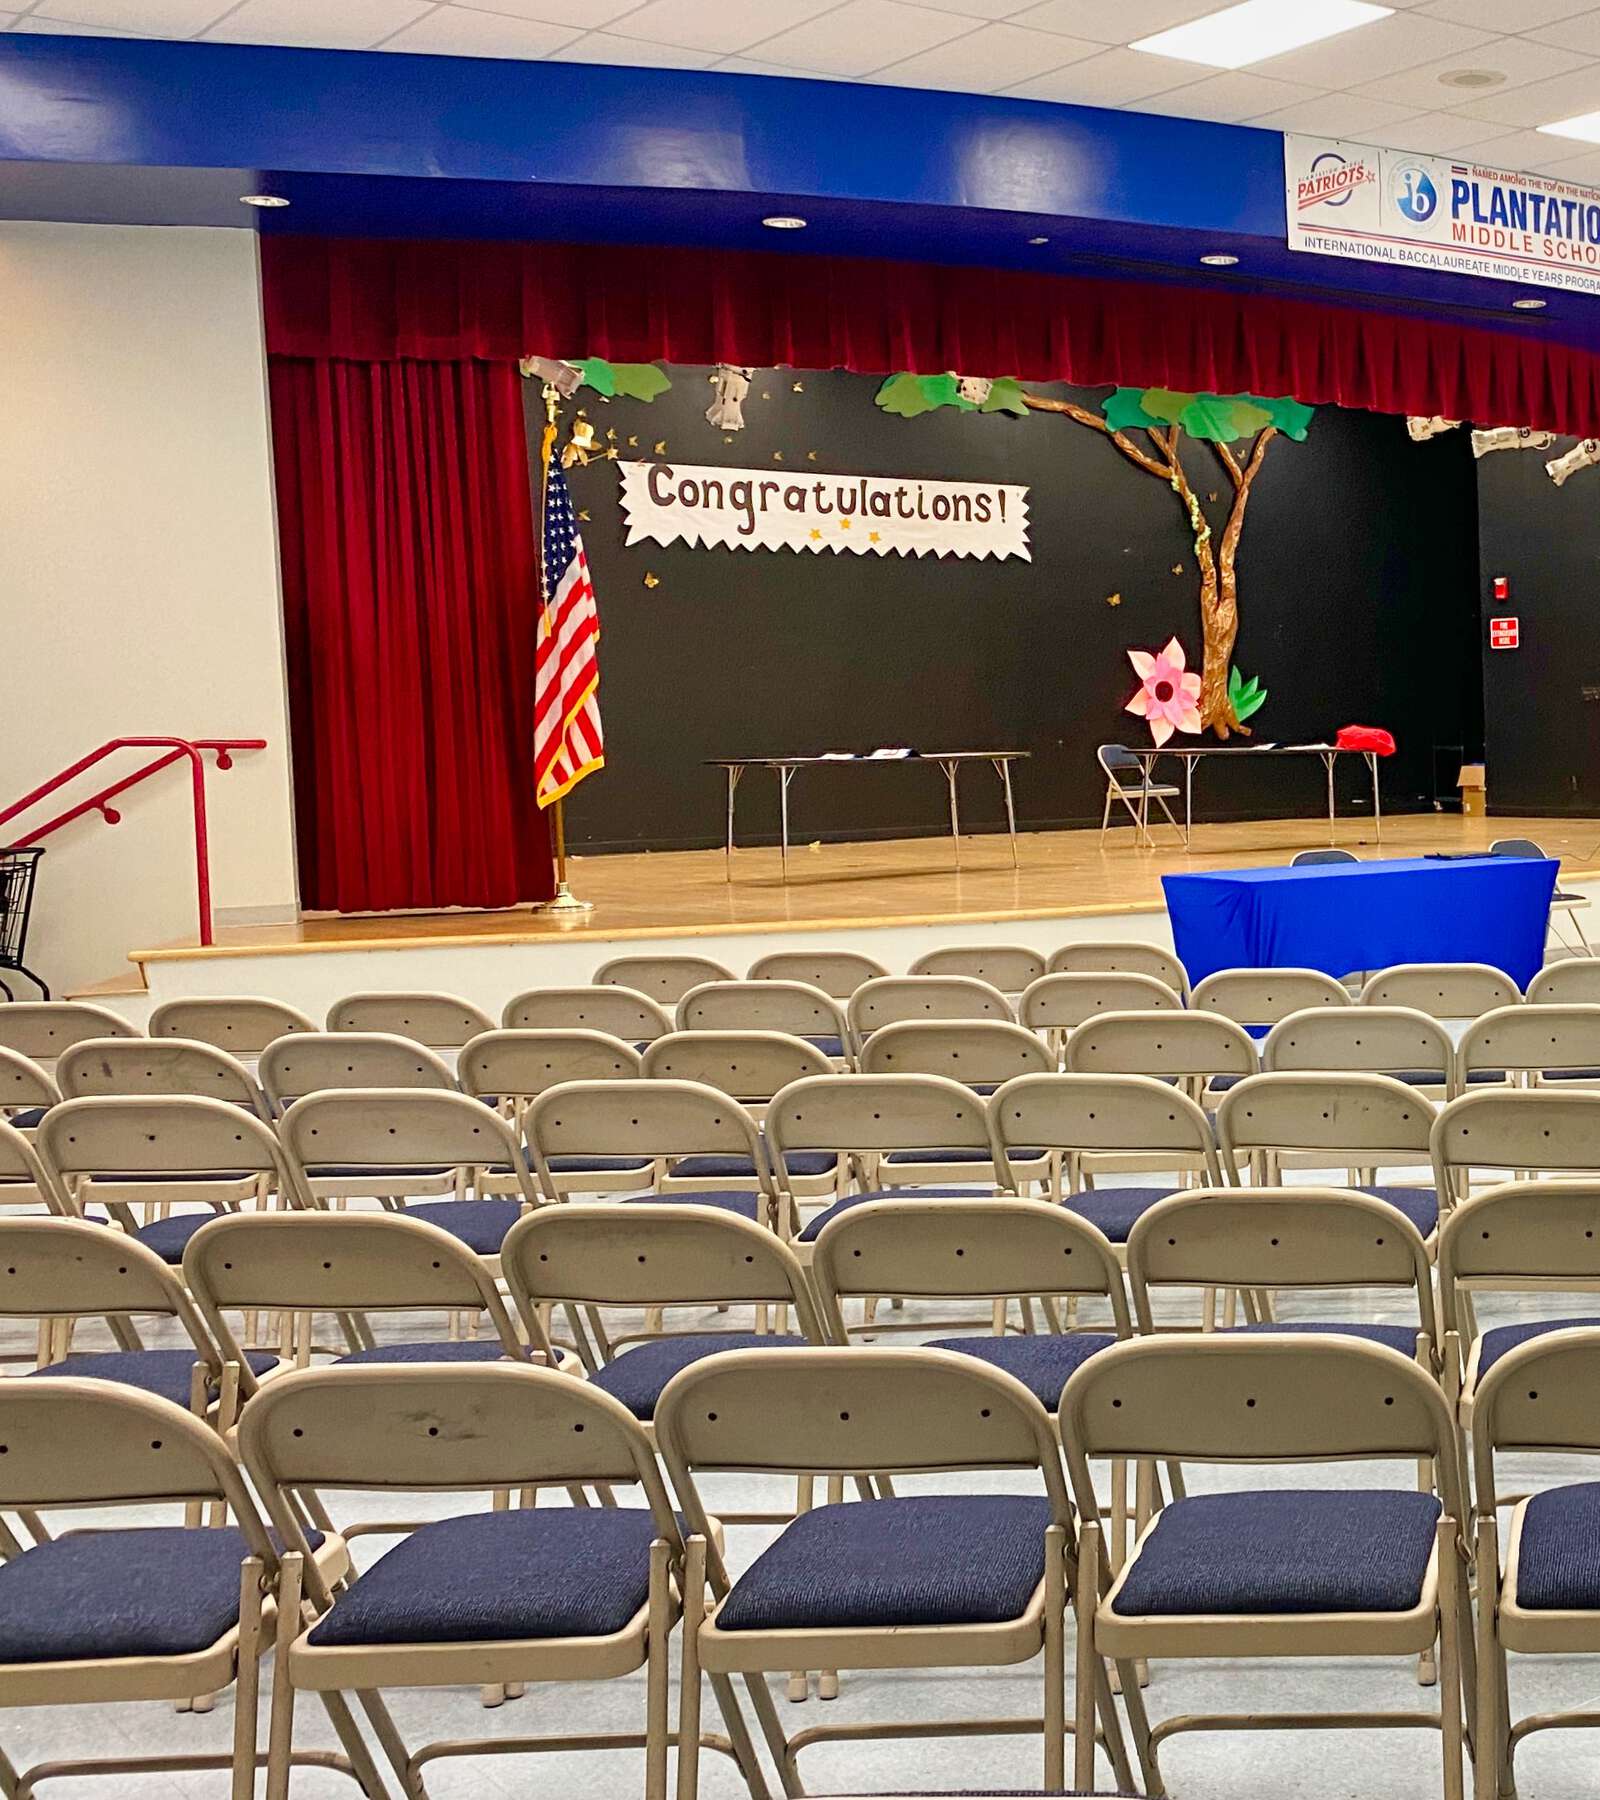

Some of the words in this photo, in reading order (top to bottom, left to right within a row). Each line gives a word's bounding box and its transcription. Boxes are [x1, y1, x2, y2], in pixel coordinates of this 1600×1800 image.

[1298, 165, 1364, 199] PATRIOTS
[1472, 165, 1498, 181] NAMED
[1500, 173, 1526, 187] AMONG
[1528, 179, 1542, 189] THE
[1543, 181, 1557, 192] TOP
[1558, 184, 1565, 193] IN
[1566, 186, 1579, 197] THE
[1452, 222, 1533, 253] MIDDLE
[1304, 236, 1397, 260] INTERNATIONAL
[1400, 249, 1490, 273] BACCALAUREATE
[1493, 263, 1529, 279] MIDDLE
[1532, 269, 1563, 285] YEARS
[647, 464, 1008, 536] Congratulations!
